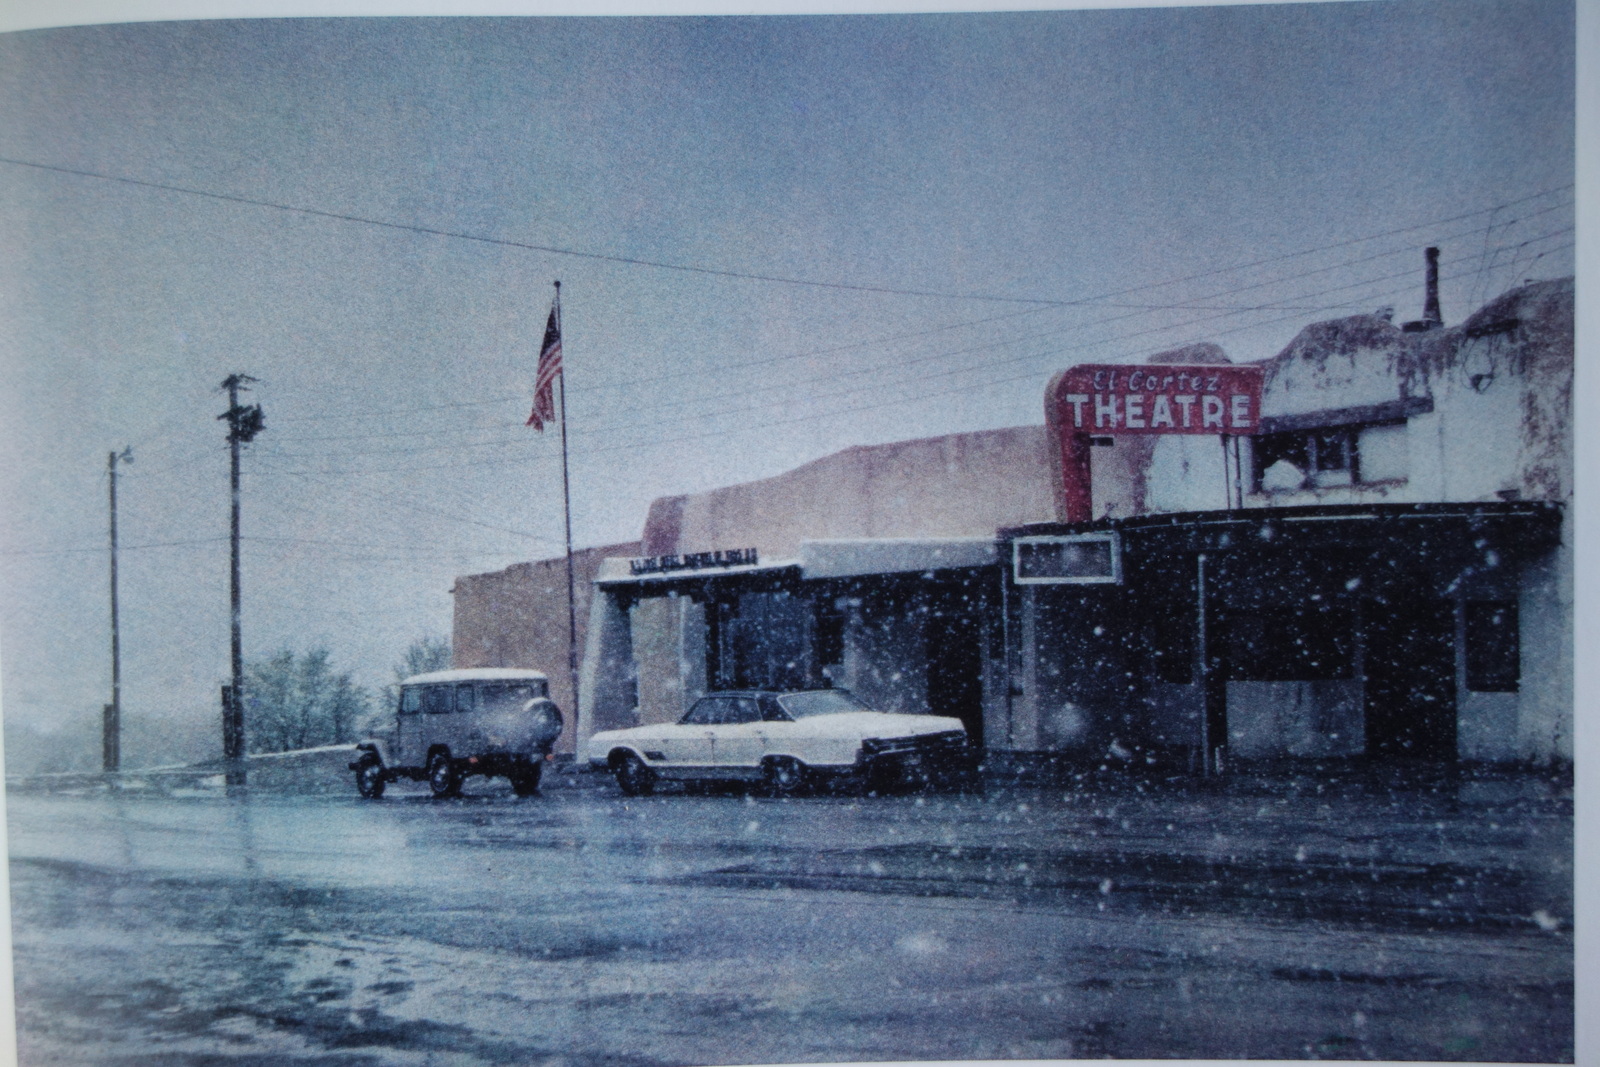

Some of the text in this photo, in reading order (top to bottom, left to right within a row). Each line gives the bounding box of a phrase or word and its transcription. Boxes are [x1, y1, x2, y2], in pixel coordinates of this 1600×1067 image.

[1093, 370, 1221, 392] El Cortez
[1066, 393, 1251, 428] THEATRE
